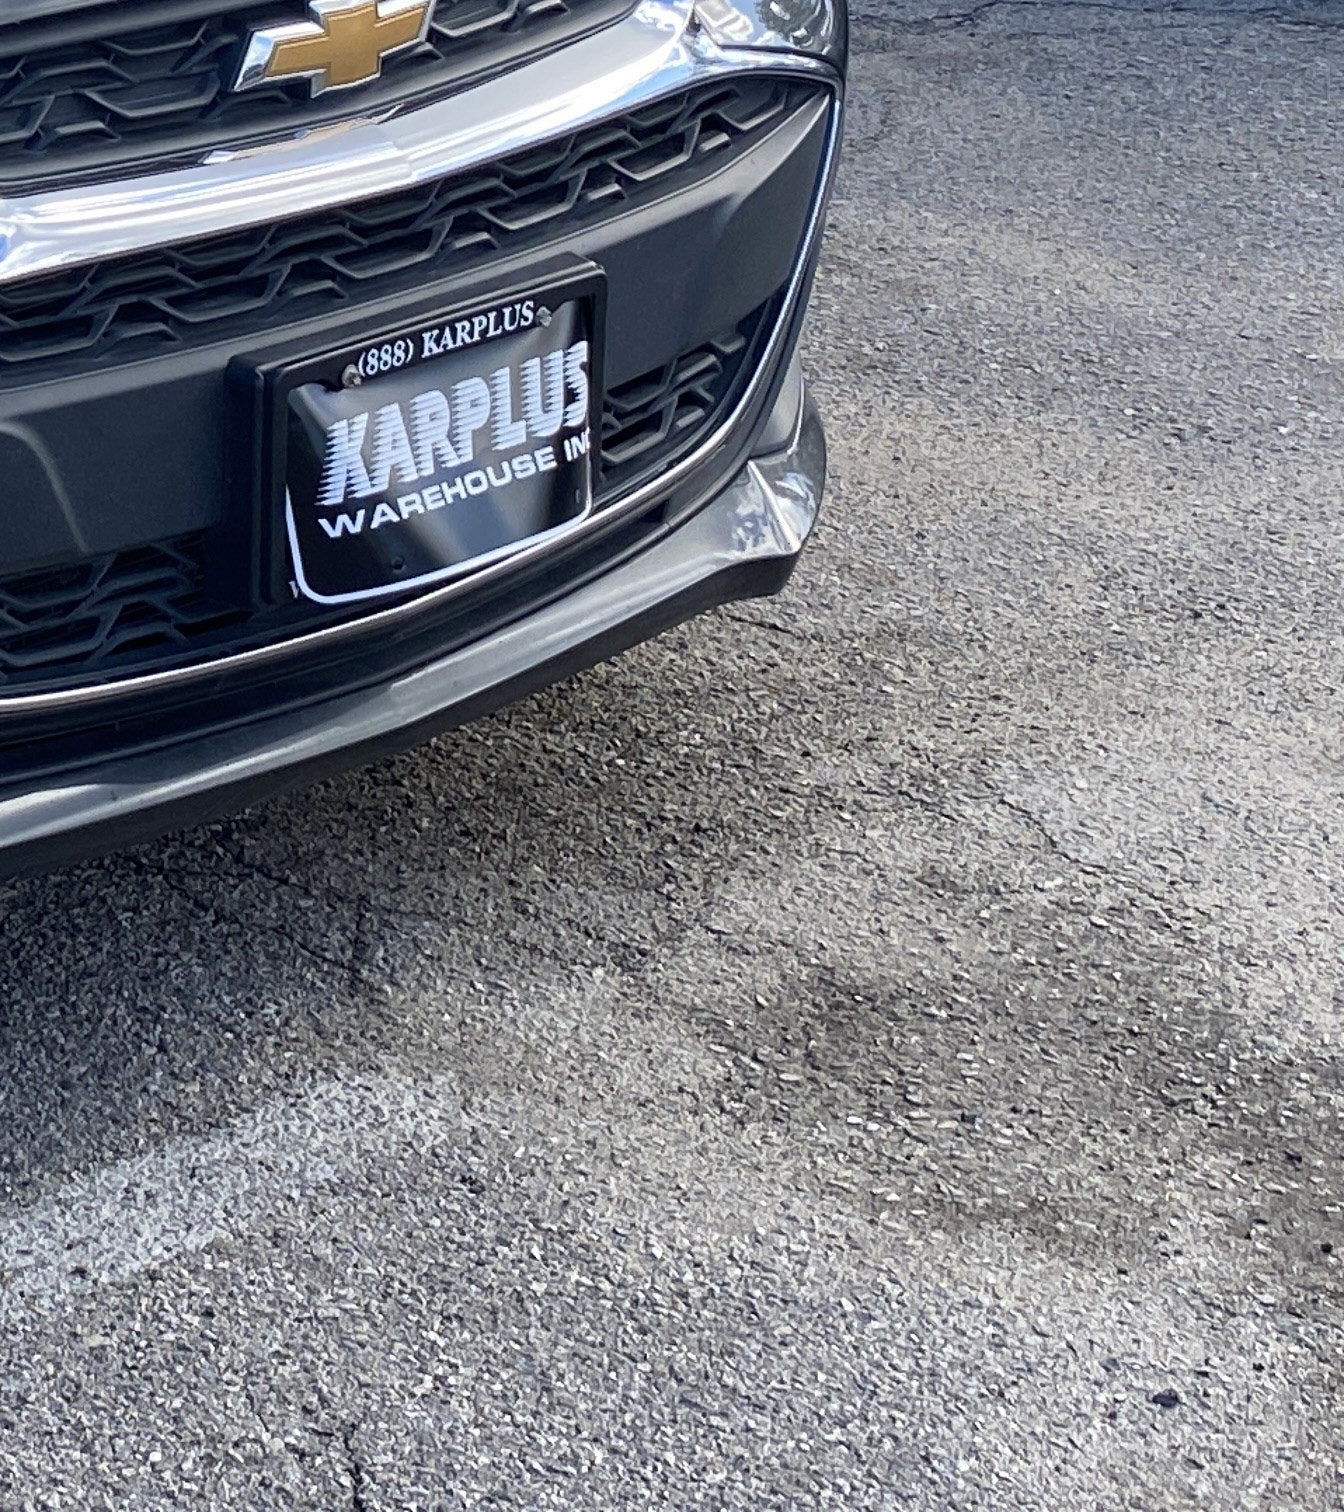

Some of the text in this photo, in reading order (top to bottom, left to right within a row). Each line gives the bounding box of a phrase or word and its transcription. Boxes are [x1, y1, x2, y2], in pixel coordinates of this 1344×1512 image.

[358, 300, 535, 377] (888) KARPLUS
[314, 340, 588, 506] KARPLUS
[318, 426, 591, 538] WAREHOUSE IN
